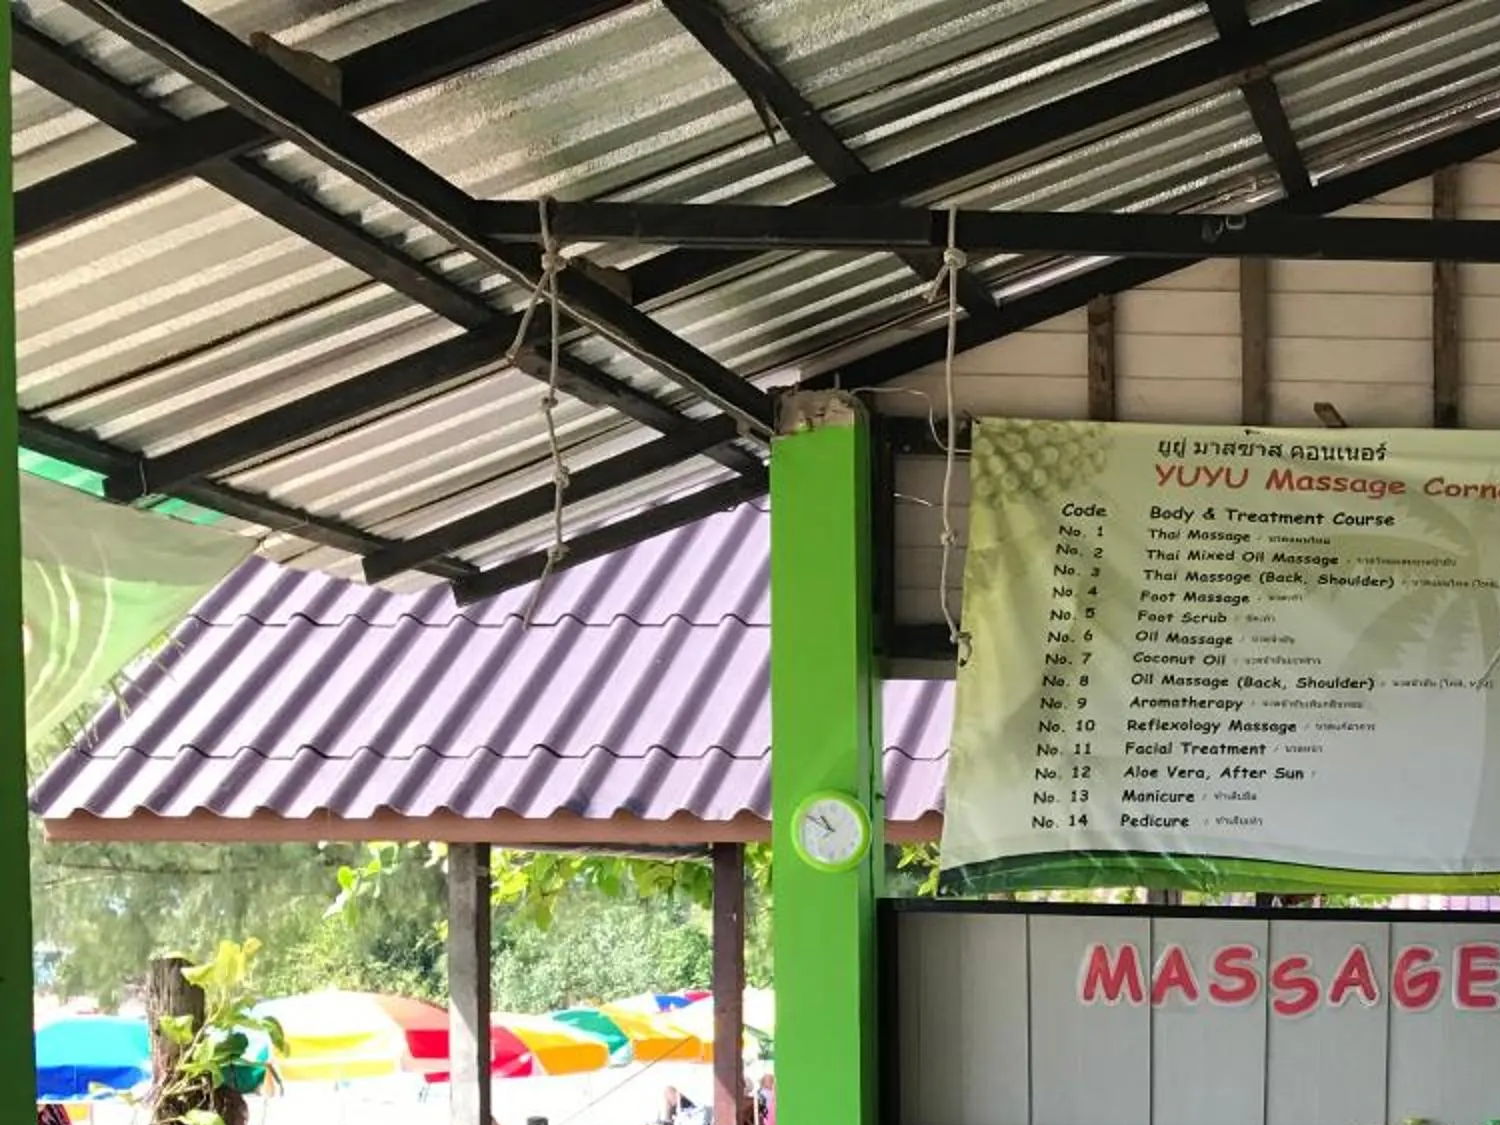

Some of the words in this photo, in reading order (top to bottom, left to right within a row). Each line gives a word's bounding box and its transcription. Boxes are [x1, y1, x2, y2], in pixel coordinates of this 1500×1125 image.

[1155, 464, 1249, 489] YUYU
[1265, 468, 1407, 499] Massage
[1061, 503, 1108, 517] Code
[1150, 505, 1195, 523] Body
[1202, 507, 1215, 520] &
[1226, 507, 1325, 525] Treatment
[1333, 511, 1396, 527] Course
[1097, 526, 1103, 537] 1
[1147, 528, 1181, 540] Thai
[1187, 529, 1251, 543] Massage
[1094, 547, 1103, 558] 2
[1146, 549, 1181, 561] Thai
[1187, 549, 1235, 562] Mixed
[1241, 551, 1265, 563] Oil
[1271, 552, 1340, 567] Massage
[1091, 567, 1100, 577] 3
[1143, 569, 1178, 581] Thai
[1184, 571, 1251, 585] Massage
[1317, 574, 1395, 589] Shoulder)
[1087, 586, 1098, 596] 4
[1139, 590, 1177, 603] Foot
[1183, 591, 1250, 606] Massage
[1137, 609, 1174, 623] Foot
[1181, 612, 1227, 624] Scrub
[1083, 629, 1093, 642] 6
[1135, 630, 1159, 643] Oil
[1165, 632, 1233, 648] Massage
[1081, 652, 1092, 664] 7
[1132, 652, 1196, 665] Coconut
[1203, 654, 1226, 666] Oil
[1079, 675, 1089, 686] 8
[1131, 673, 1154, 685] Oil
[1161, 675, 1229, 690] Massage
[1296, 676, 1375, 691] Shoulder)
[1077, 698, 1087, 709] 9
[1129, 696, 1244, 711] Aromatherapy
[1076, 719, 1096, 732] 10
[1127, 718, 1221, 735] Reflexology
[1228, 719, 1298, 735] Massage
[1073, 742, 1092, 755] 11
[1125, 741, 1173, 755] Facial
[1180, 741, 1267, 756] Treatment
[1071, 766, 1091, 779] 12
[1123, 765, 1159, 778] Aloe
[1167, 766, 1211, 780] Vera,
[1219, 765, 1268, 779] After
[1273, 767, 1305, 780] Sun
[1071, 789, 1089, 803] 13
[1121, 789, 1195, 803] Manicure
[1068, 814, 1088, 827] 14
[1120, 813, 1190, 827] Pedicure
